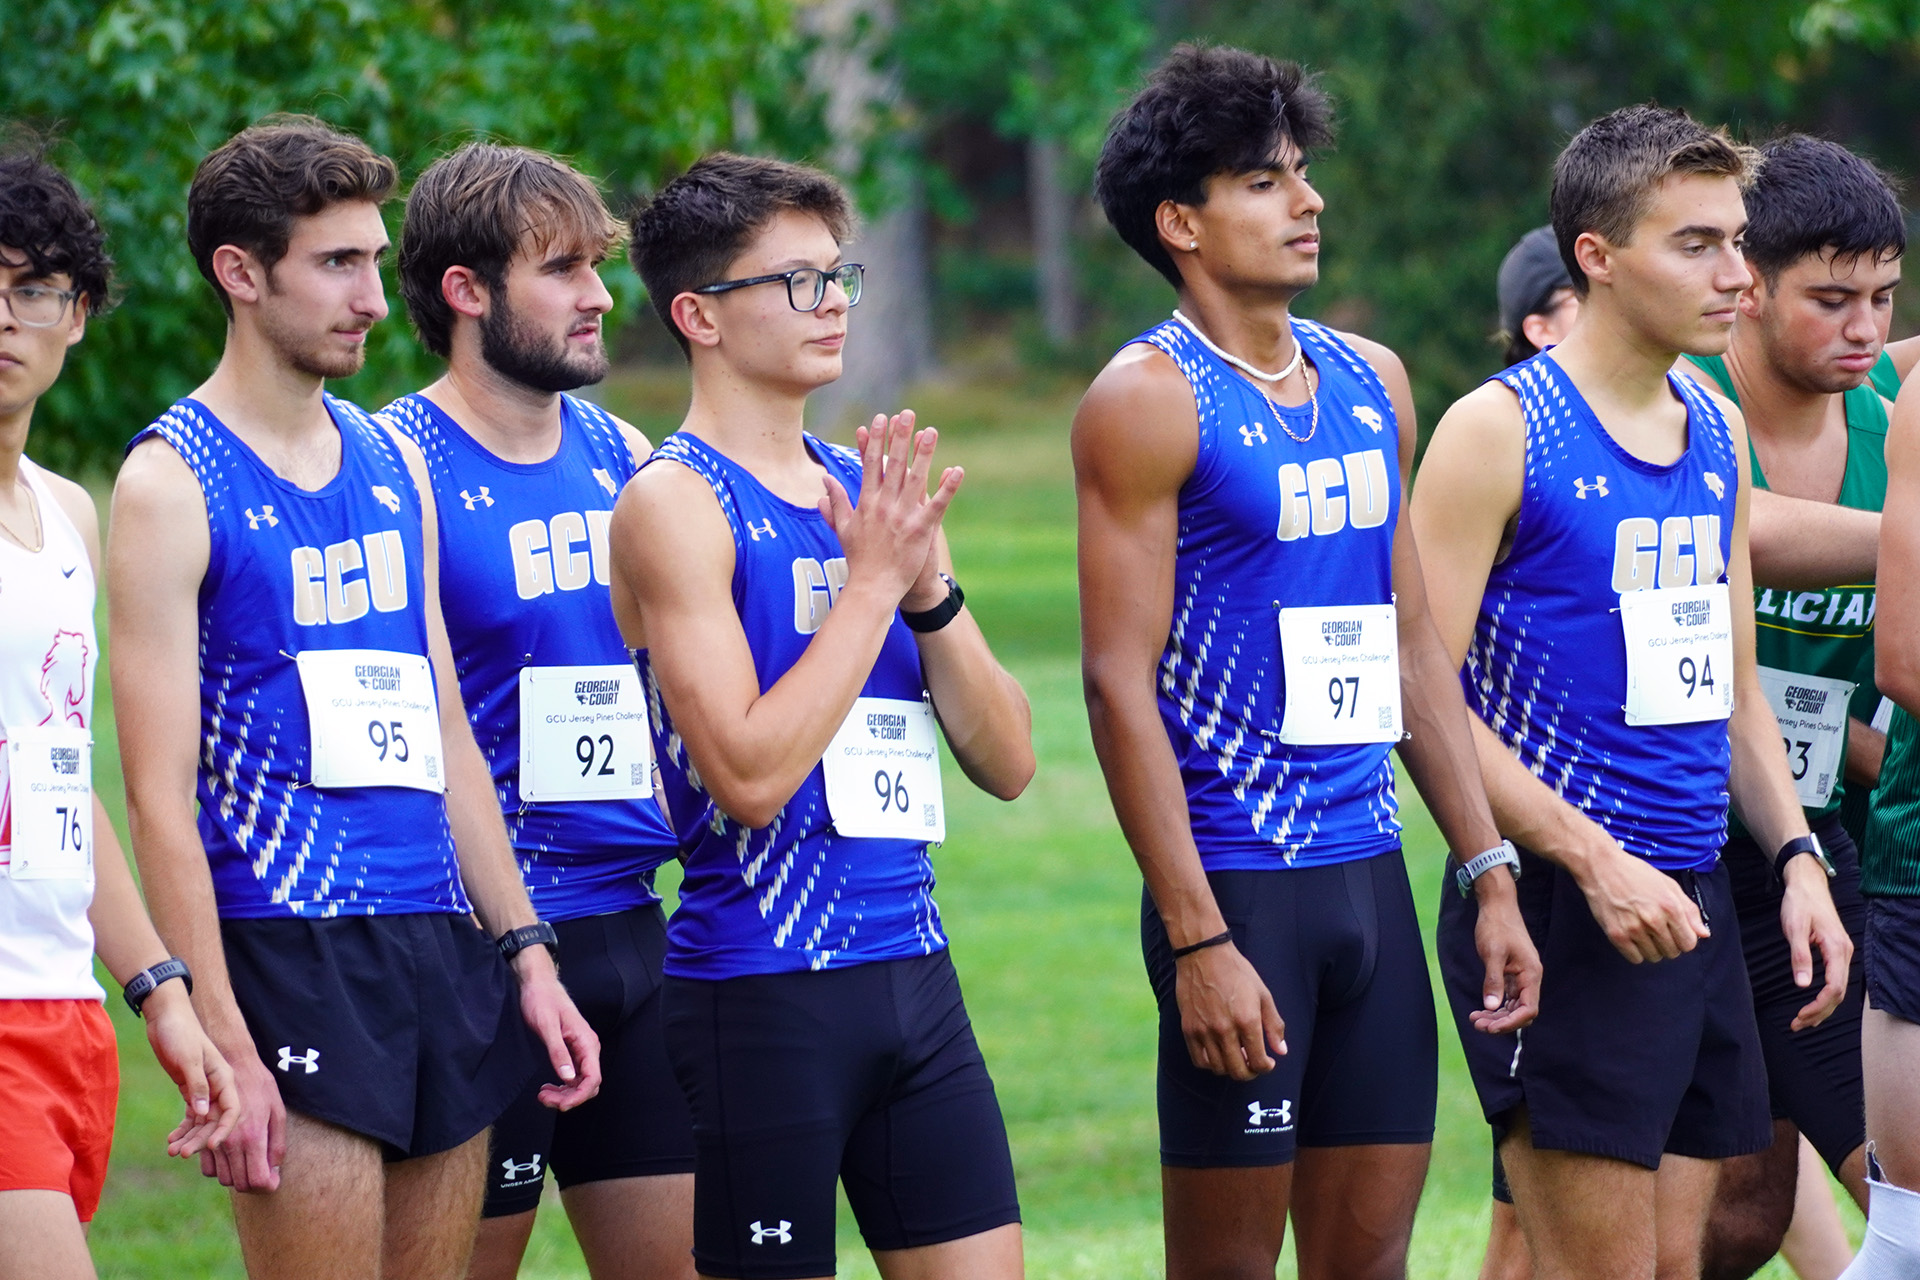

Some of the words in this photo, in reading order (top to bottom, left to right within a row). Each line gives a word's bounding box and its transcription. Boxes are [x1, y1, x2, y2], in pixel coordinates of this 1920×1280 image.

[1276, 449, 1390, 541] GCU
[508, 510, 614, 600] GCU
[1611, 514, 1725, 594] GCU
[291, 529, 408, 626] GCU
[1671, 599, 1711, 615] GEORGIAN
[1754, 588, 1877, 626] LICIA
[1321, 620, 1363, 634] GEORGIAN
[1686, 612, 1711, 627] COURT
[1334, 633, 1362, 647] COURT
[1648, 637, 1667, 647] GCU
[1302, 655, 1318, 664] GCU
[355, 664, 401, 679] GEORGIAN
[1678, 654, 1715, 699] 94
[372, 677, 401, 691] COURT
[574, 679, 620, 694] GEORGIAN
[589, 692, 619, 706] COURT
[1328, 677, 1360, 719] 97
[1784, 685, 1829, 703] GEORGIAN
[331, 698, 353, 707] GCU
[1795, 700, 1825, 715] COURT
[545, 714, 567, 724] GCU
[568, 714, 595, 724] Jersey
[596, 712, 614, 722] Pines
[867, 713, 907, 728] GEORGIAN
[1799, 719, 1817, 730] Pines
[880, 726, 906, 741] COURT
[368, 720, 409, 763] 95
[576, 734, 615, 777] 92
[844, 746, 863, 755] GCU
[874, 769, 909, 813] 96
[56, 807, 82, 851] 76
